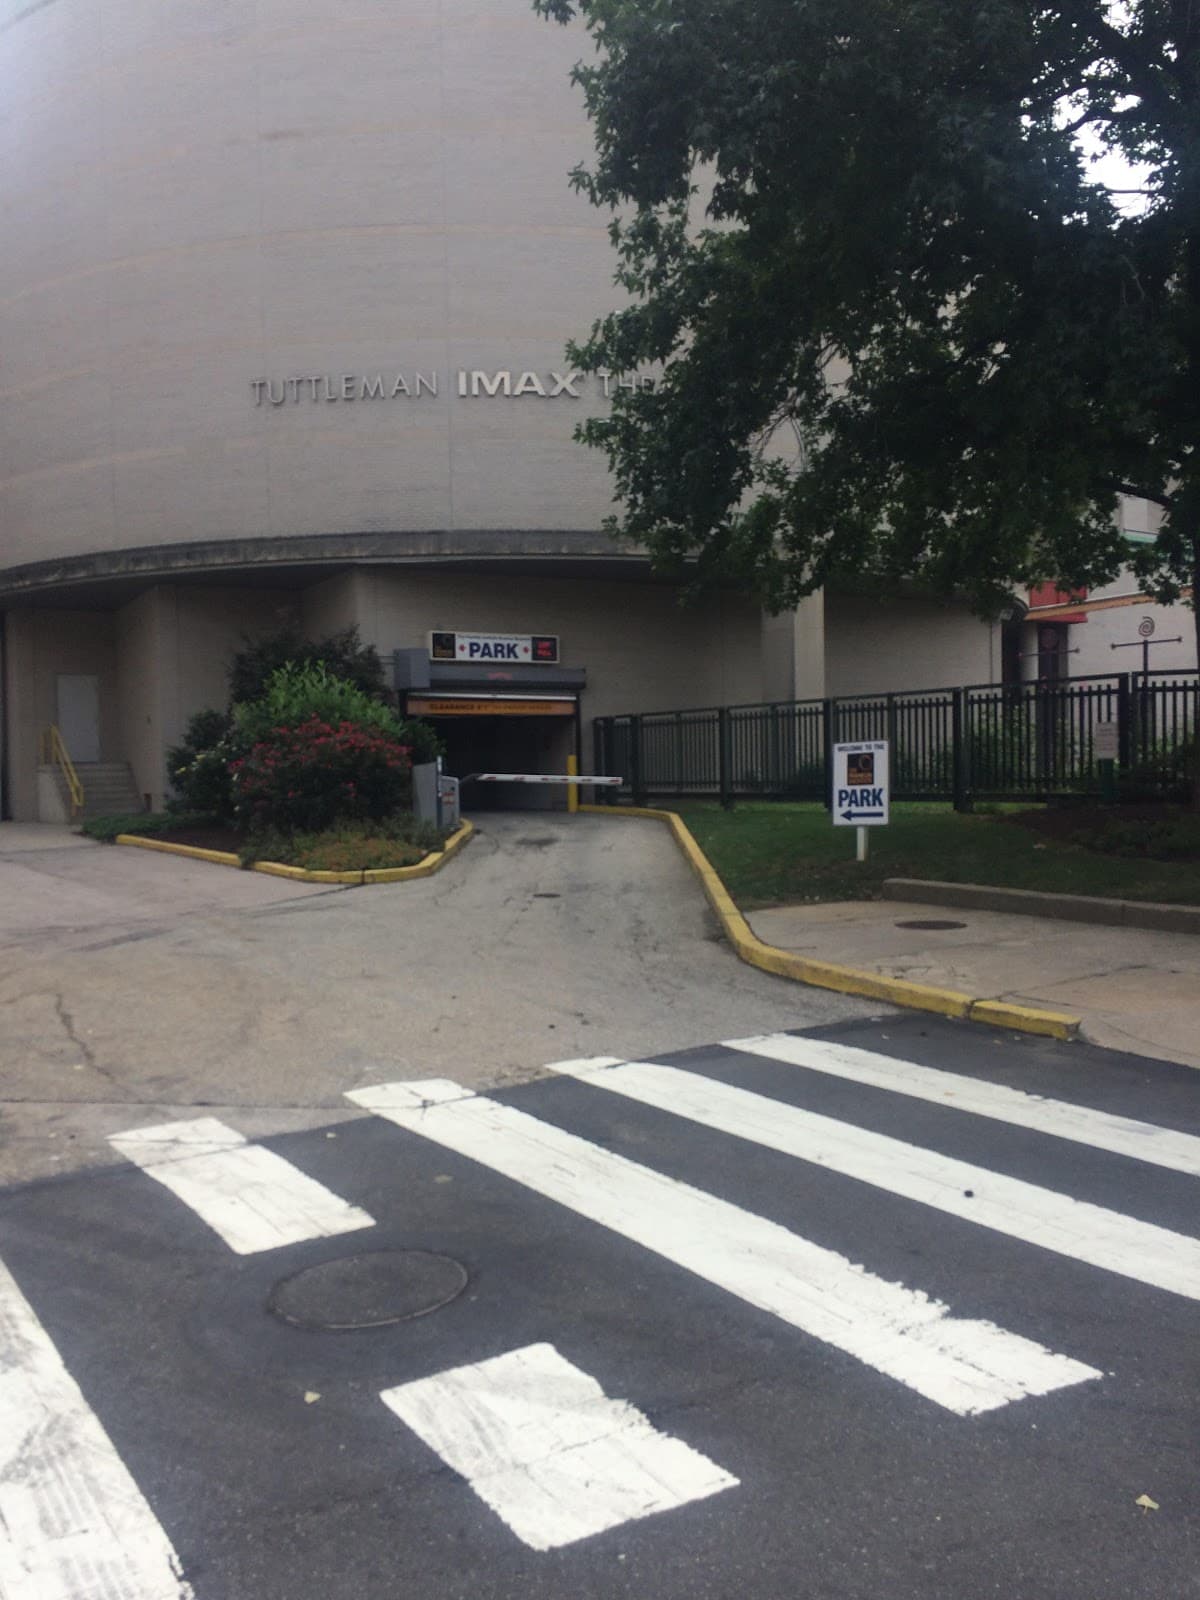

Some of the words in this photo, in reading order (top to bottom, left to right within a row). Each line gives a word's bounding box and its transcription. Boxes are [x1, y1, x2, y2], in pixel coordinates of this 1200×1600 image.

[250, 371, 437, 406] TUTTLEMAN
[458, 371, 580, 398] IMAX
[469, 642, 519, 659] PARK
[838, 788, 883, 807] PARK
